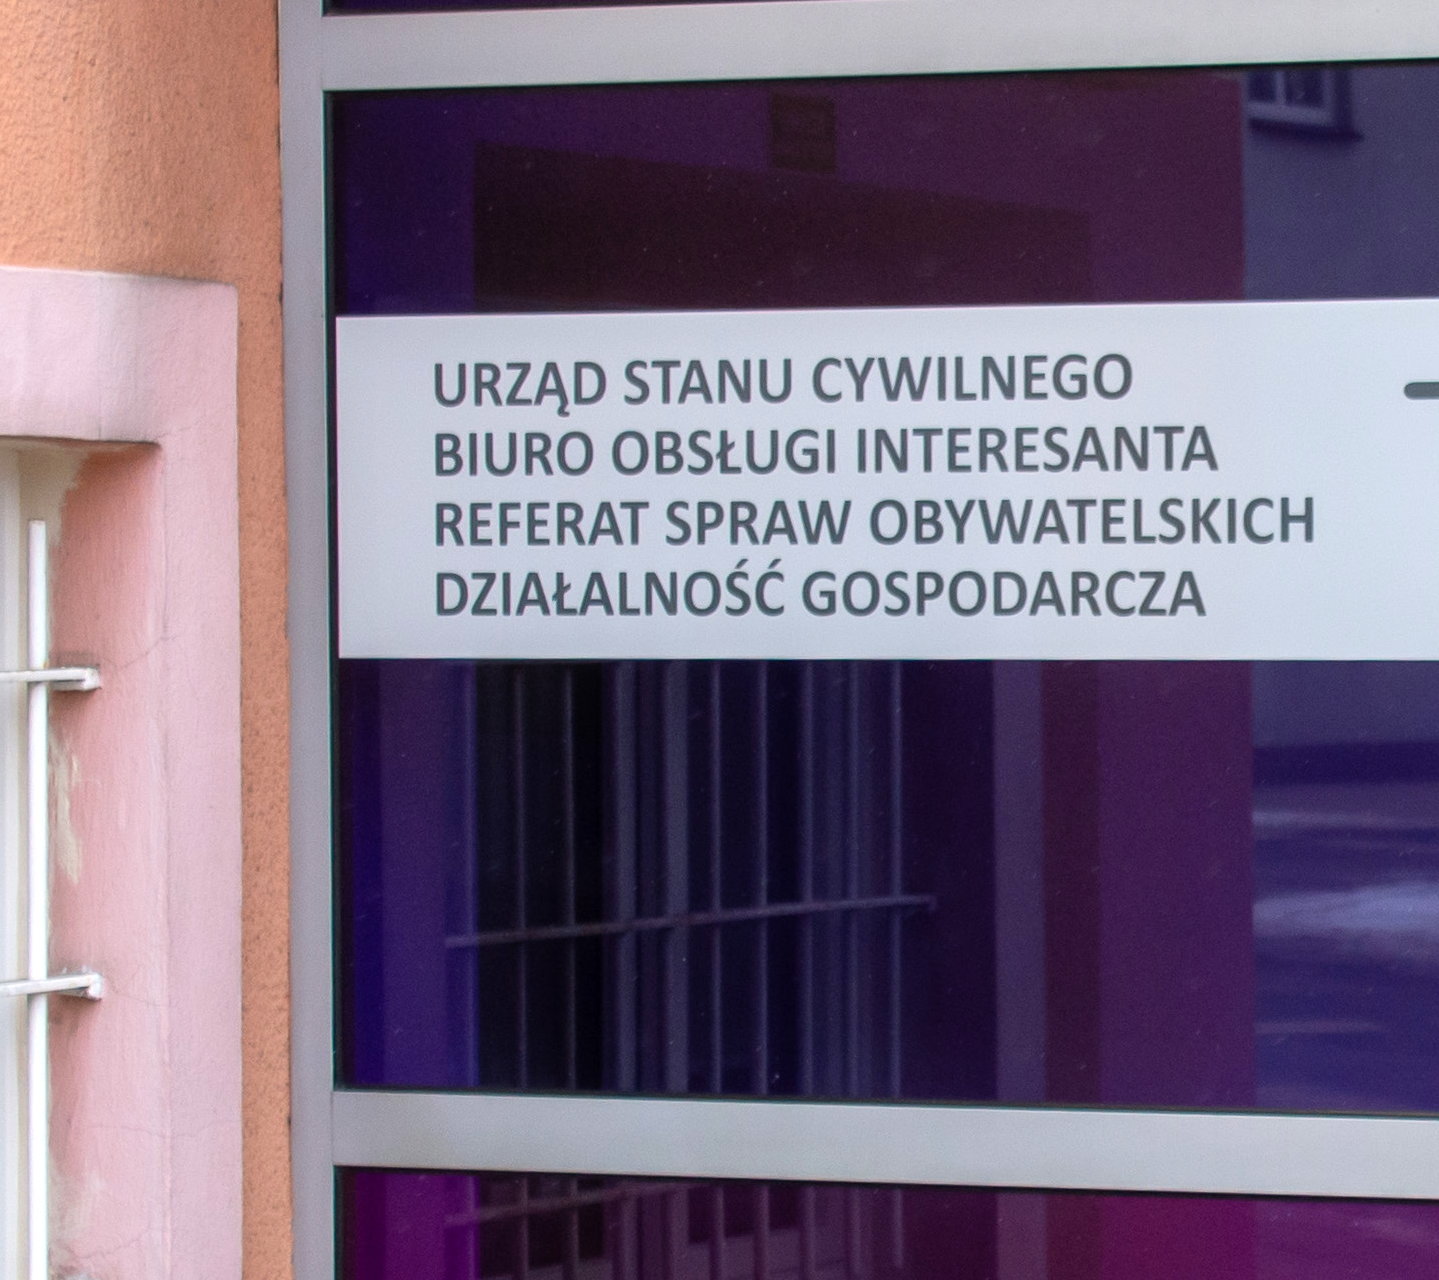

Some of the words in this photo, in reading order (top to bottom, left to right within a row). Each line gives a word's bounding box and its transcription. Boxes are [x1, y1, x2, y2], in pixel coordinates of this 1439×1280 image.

[434, 359, 607, 418] URZĄD
[623, 358, 792, 406] STANU
[812, 353, 1133, 403] CYWILNEGO
[434, 430, 594, 477] BIURO
[611, 428, 836, 476] OBSŁUGI
[857, 425, 1219, 474] INTERESANTA
[435, 500, 650, 547] REFERAT
[665, 499, 852, 546] SPRAW
[869, 496, 1314, 546] OBYWATELSKICH
[435, 557, 785, 617] DZIAŁALNOŚĆ
[801, 569, 1207, 617] GOSPODARCZA
